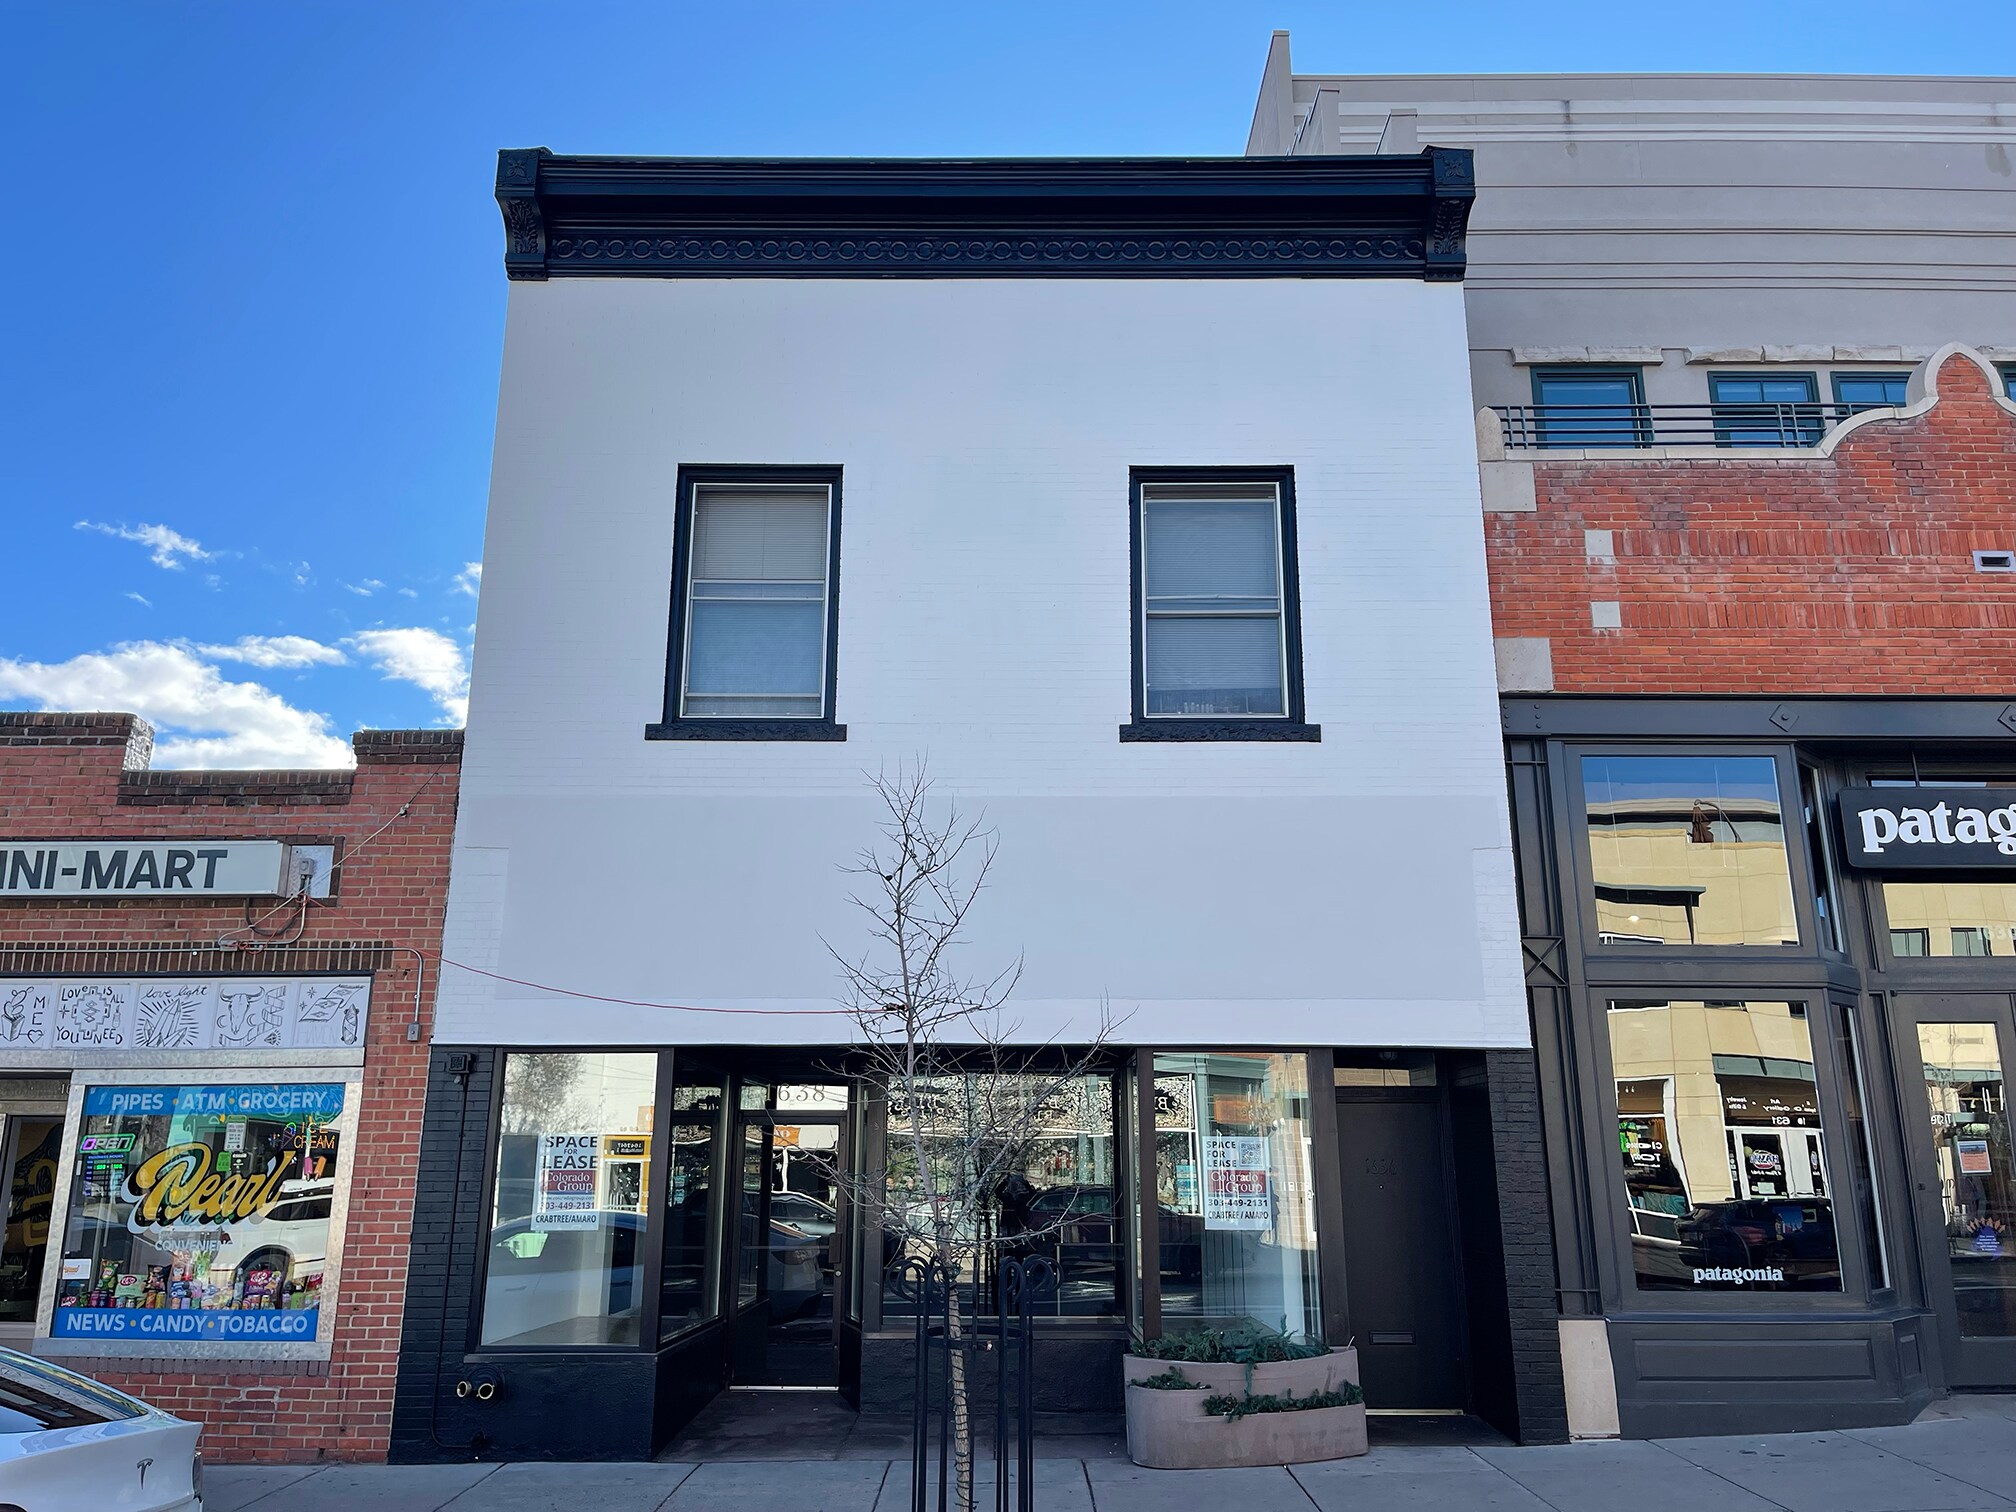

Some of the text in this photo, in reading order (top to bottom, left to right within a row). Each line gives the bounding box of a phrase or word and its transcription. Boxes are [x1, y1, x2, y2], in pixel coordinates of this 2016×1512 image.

[143, 986, 172, 999] love
[111, 1091, 328, 1110] PIPES ATM GROCERY
[301, 1121, 329, 1134] ICE
[293, 1134, 336, 1149] CREAM
[545, 1136, 598, 1148] SPACE
[1206, 1141, 1237, 1149] SPACE
[1206, 1150, 1226, 1158] FOR
[543, 1155, 598, 1169] LEASE
[1207, 1159, 1237, 1168] LEASE
[547, 1172, 590, 1182] Colorado
[1211, 1171, 1259, 1182] Colorado
[126, 1140, 297, 1226] Pearl
[556, 1181, 593, 1193] Group
[1225, 1181, 1263, 1193] Group
[1692, 1265, 1784, 1285] patagonia
[66, 1313, 308, 1333] NEWS CANDY TOBACCO
